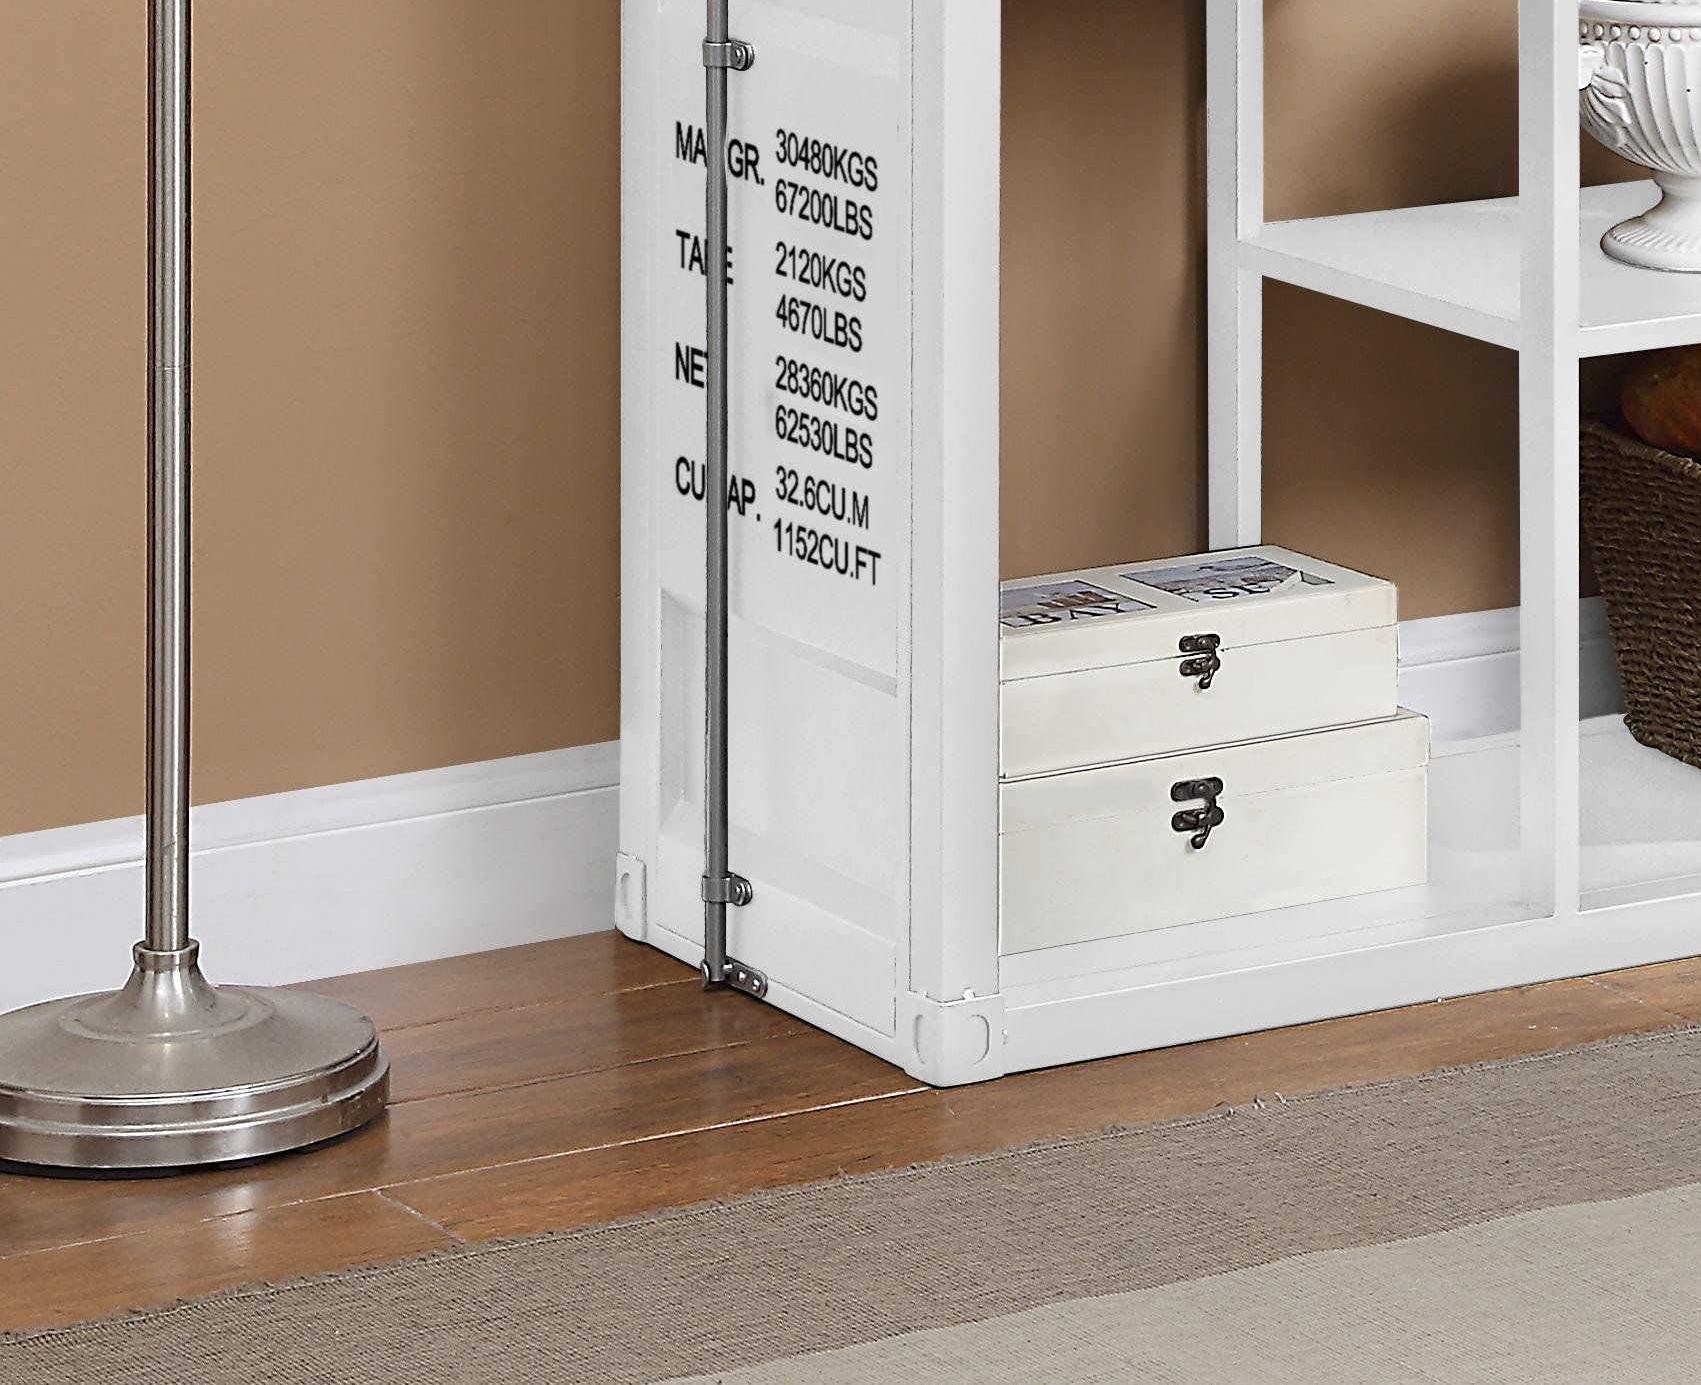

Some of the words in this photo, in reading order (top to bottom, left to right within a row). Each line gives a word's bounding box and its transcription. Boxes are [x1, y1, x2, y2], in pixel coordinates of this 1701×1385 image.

[675, 120, 707, 168] MA
[727, 138, 765, 185] GR.
[775, 128, 878, 192] 30480KGS
[775, 178, 873, 241] 67200LBS
[675, 229, 734, 285] TA
[775, 240, 867, 302] 2120KGS
[776, 293, 862, 353] 4670LBS
[675, 341, 708, 389] NE
[775, 355, 878, 421] 28360KGS
[775, 404, 873, 469] 62530LBS
[727, 474, 761, 522] AP.
[775, 465, 869, 530] 32.6CU.M
[773, 517, 882, 586] 1152CU.FT
